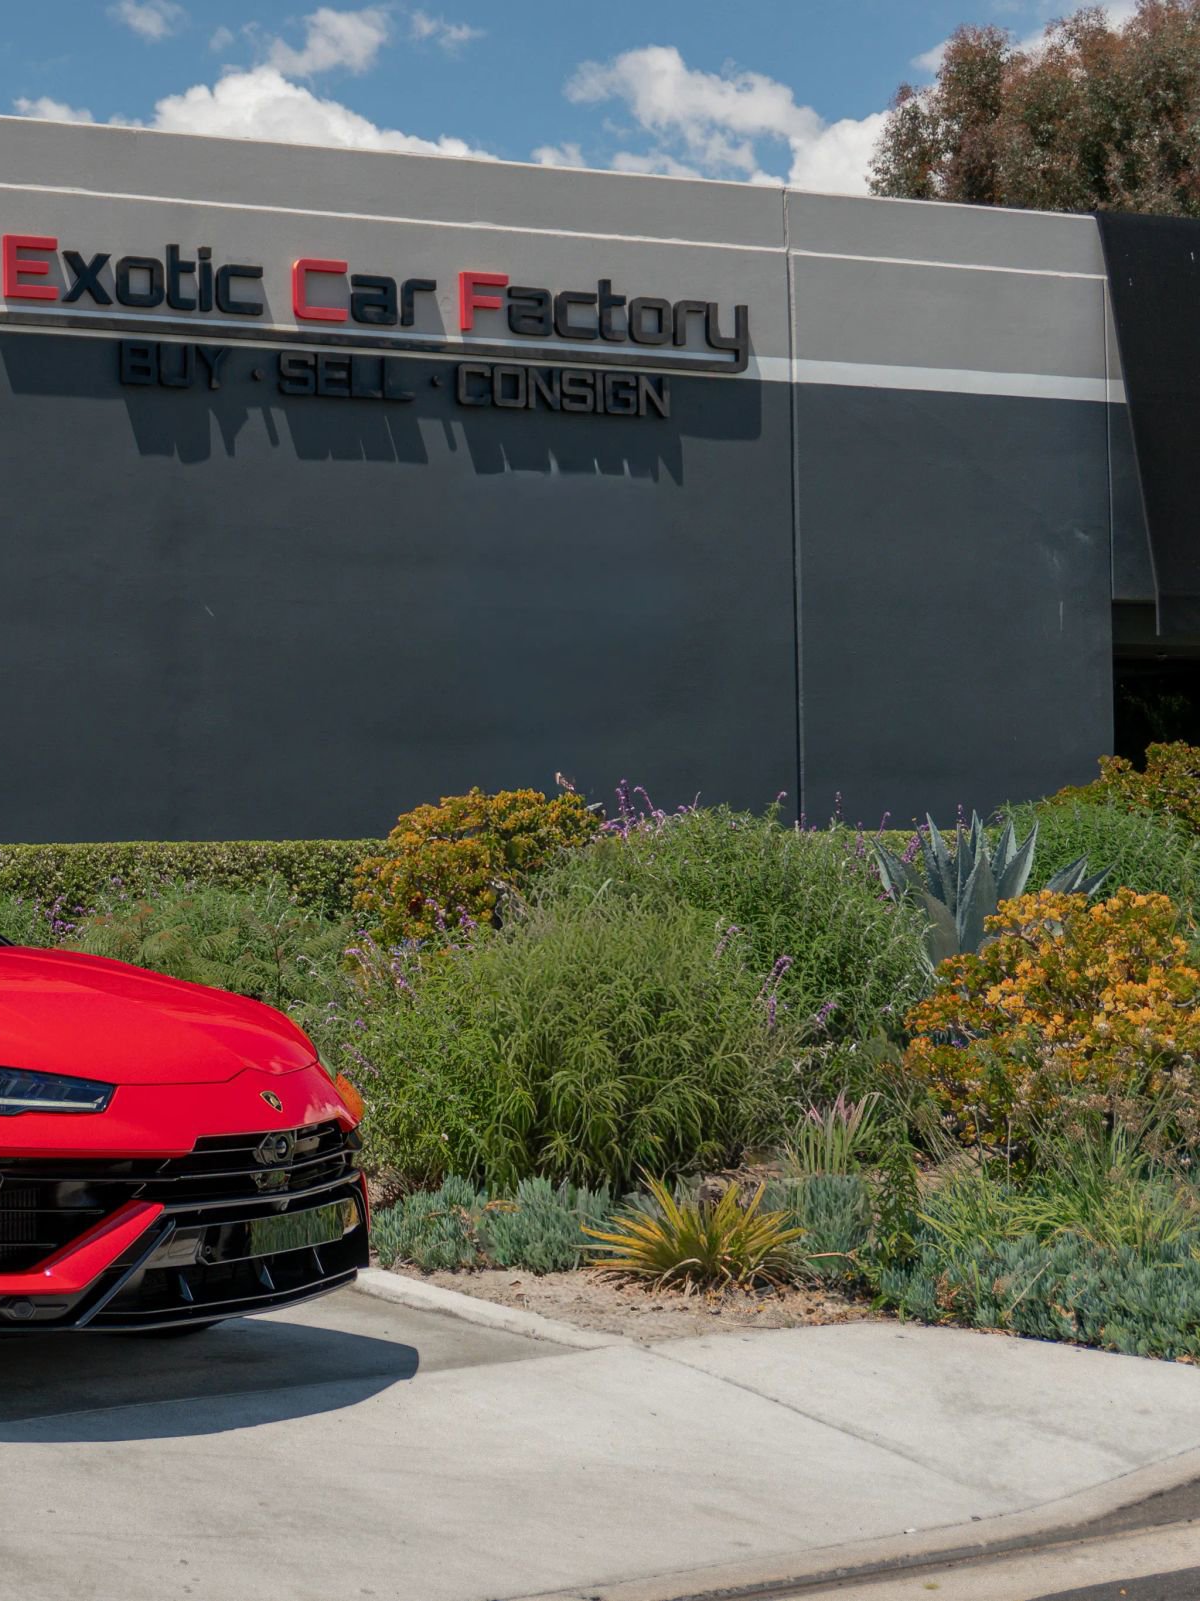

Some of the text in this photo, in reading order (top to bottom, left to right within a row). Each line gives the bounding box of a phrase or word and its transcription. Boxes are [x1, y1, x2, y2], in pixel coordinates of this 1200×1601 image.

[2, 234, 749, 373] Exotic Car Factory
[120, 338, 671, 418] BUY SELL CONSIGN
